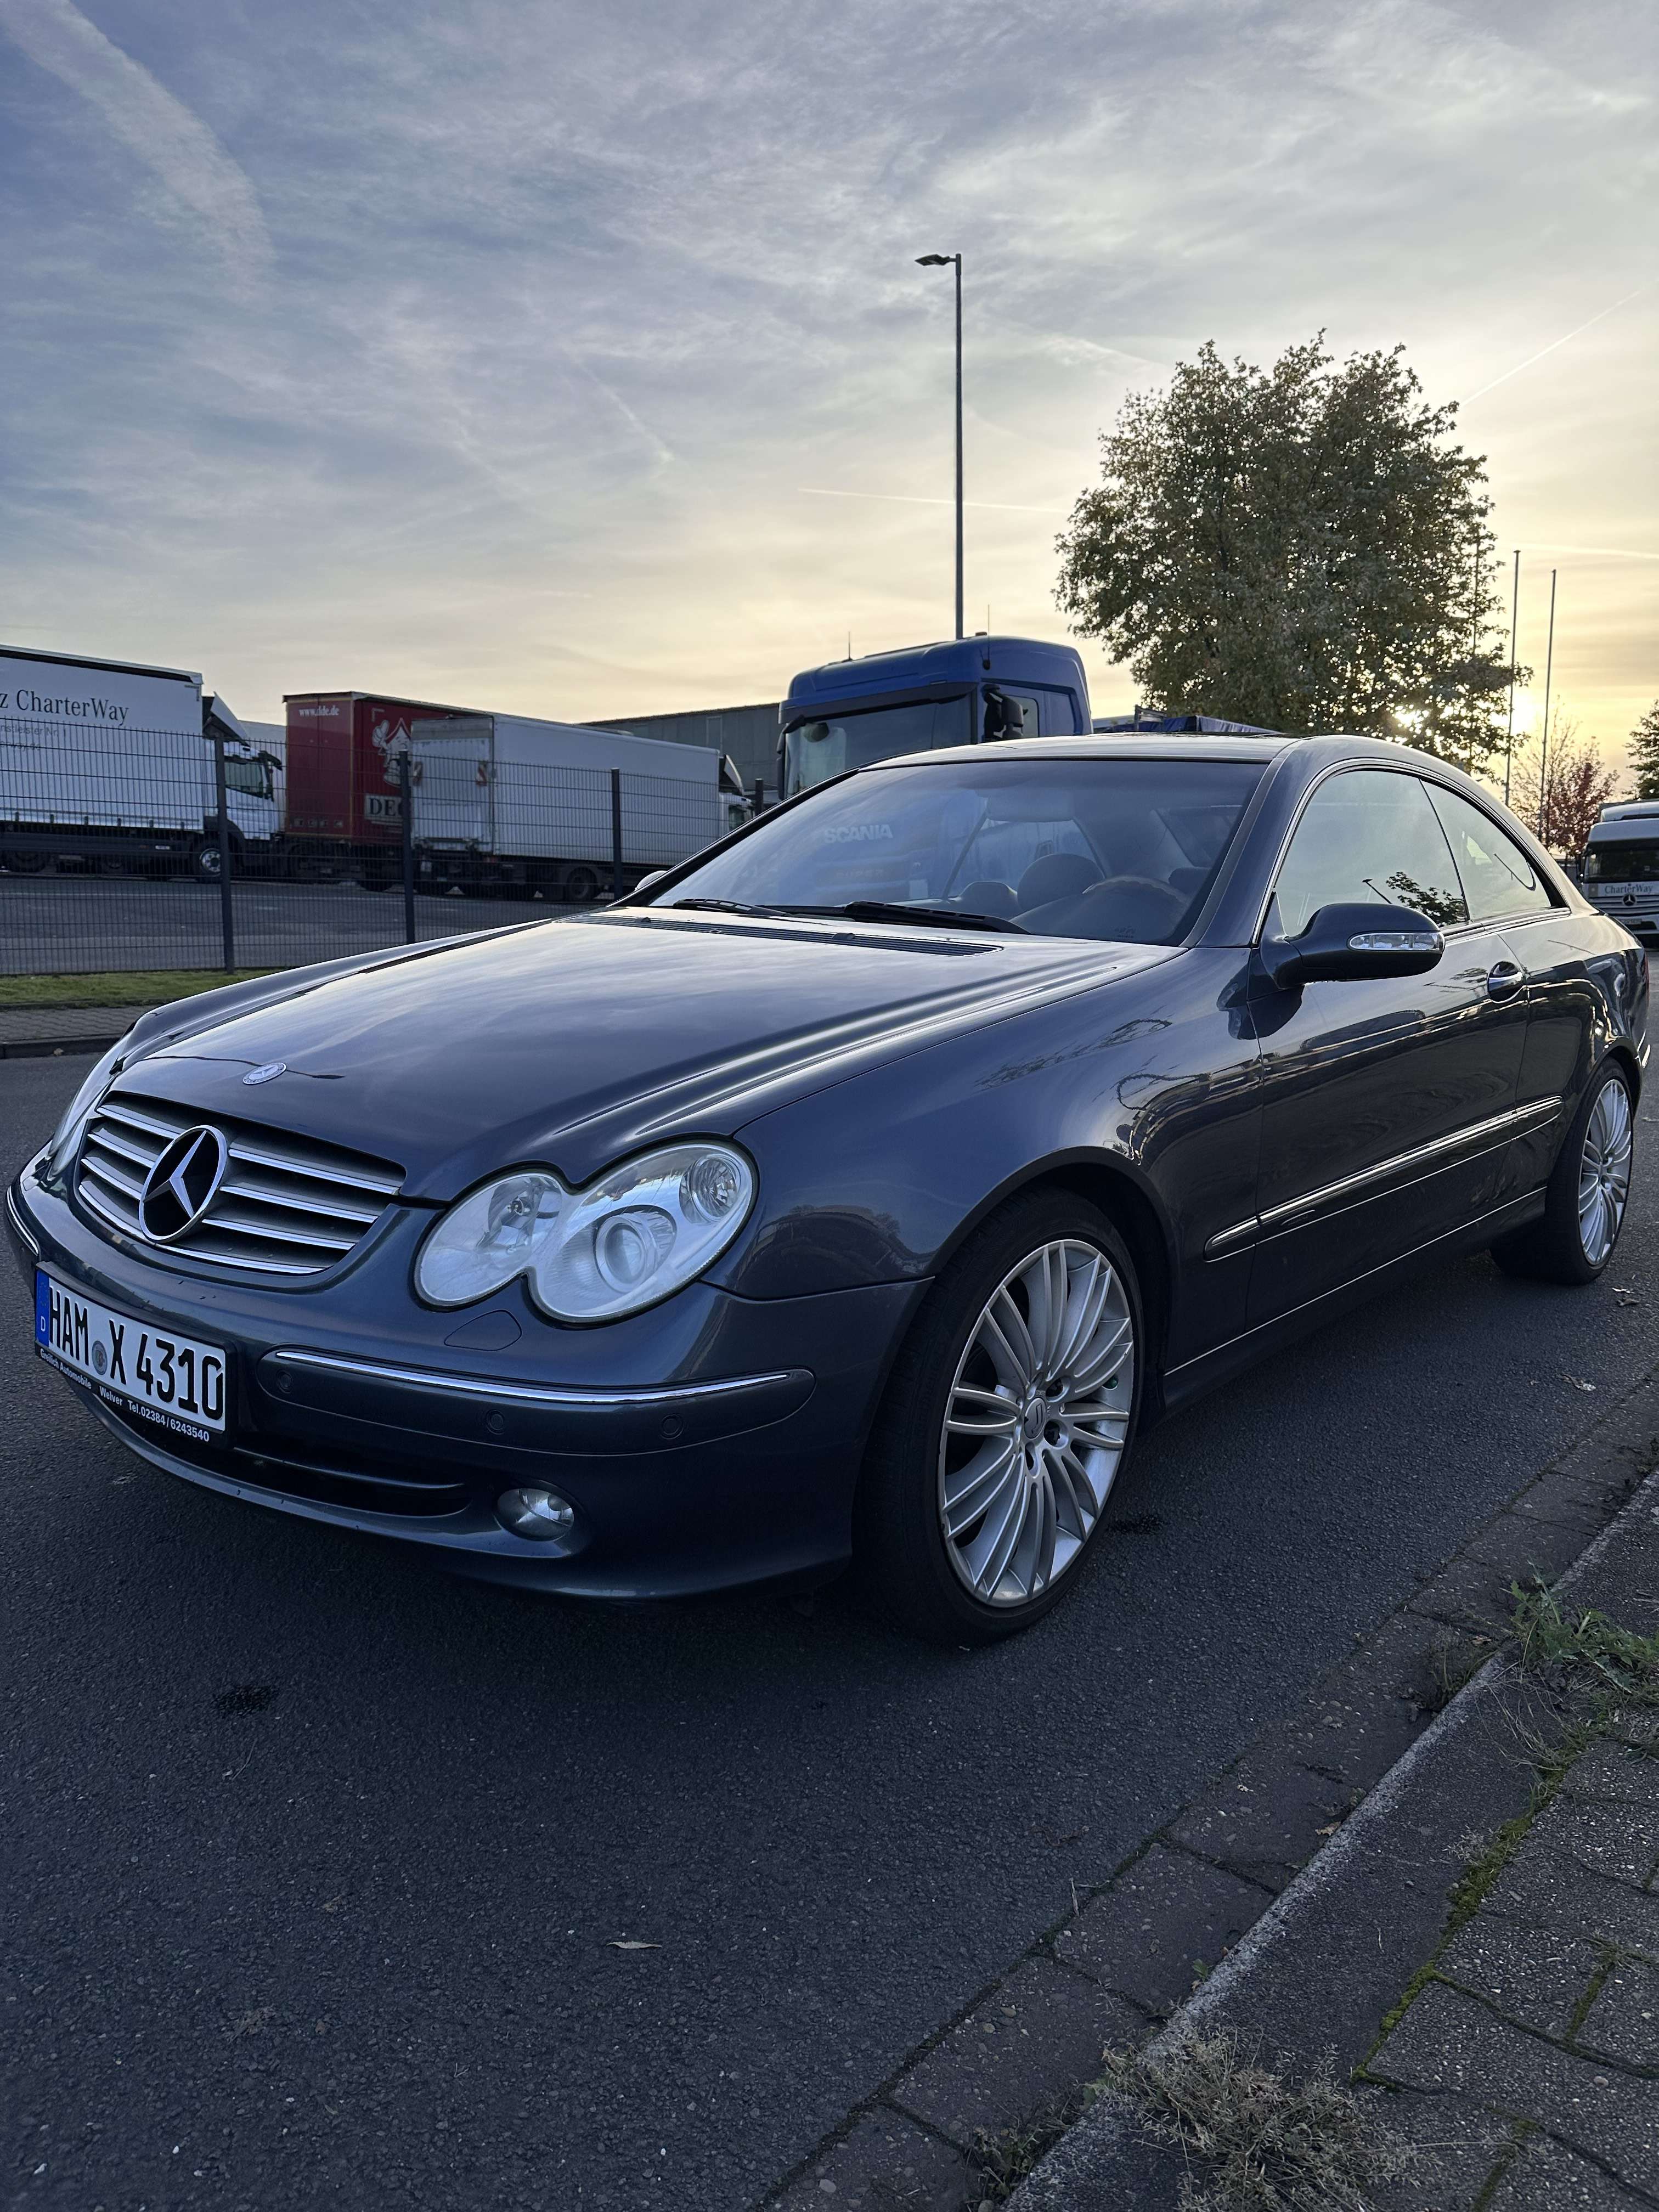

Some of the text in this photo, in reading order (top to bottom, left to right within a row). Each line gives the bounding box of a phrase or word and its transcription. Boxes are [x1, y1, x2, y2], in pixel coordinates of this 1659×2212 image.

[16, 689, 129, 726] CharterWay
[824, 824, 893, 843] SCANIA
[1605, 884, 1653, 894] CharterWay
[41, 1316, 46, 1331] D
[49, 1286, 223, 1420] HAM X 4310
[60, 1362, 92, 1390] Automobile
[99, 1386, 123, 1406] Welver
